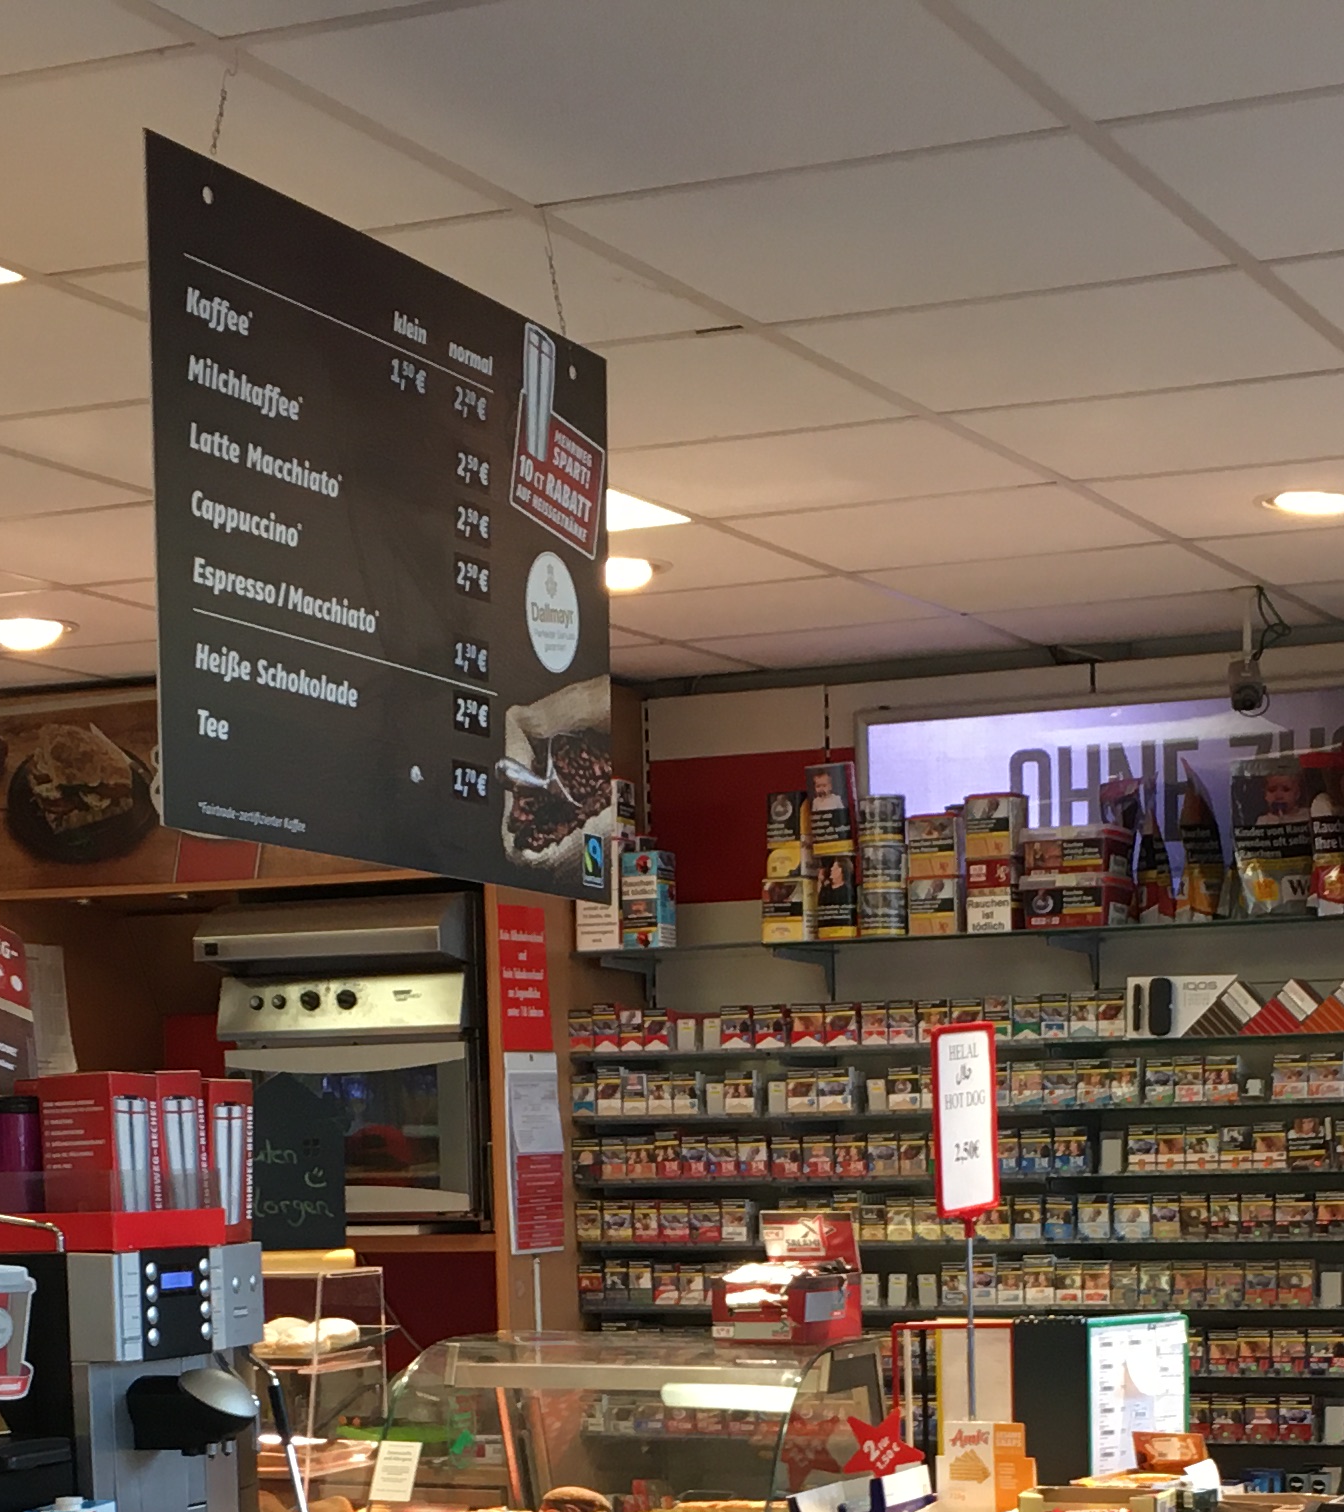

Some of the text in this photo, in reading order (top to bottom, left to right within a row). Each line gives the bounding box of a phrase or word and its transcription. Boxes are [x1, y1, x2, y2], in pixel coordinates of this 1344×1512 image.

[393, 311, 427, 344] klein
[449, 342, 493, 376] normal
[190, 422, 240, 463] Latte
[552, 447, 591, 490] SPART!
[519, 455, 592, 523] 10 RABATT
[531, 602, 575, 626] Dallmayr
[195, 643, 358, 708] Heiße Schokolade
[197, 709, 229, 740] Tee
[948, 1042, 979, 1061] HELAL
[944, 1089, 986, 1110] HOT DOG
[863, 1440, 881, 1461] 2
